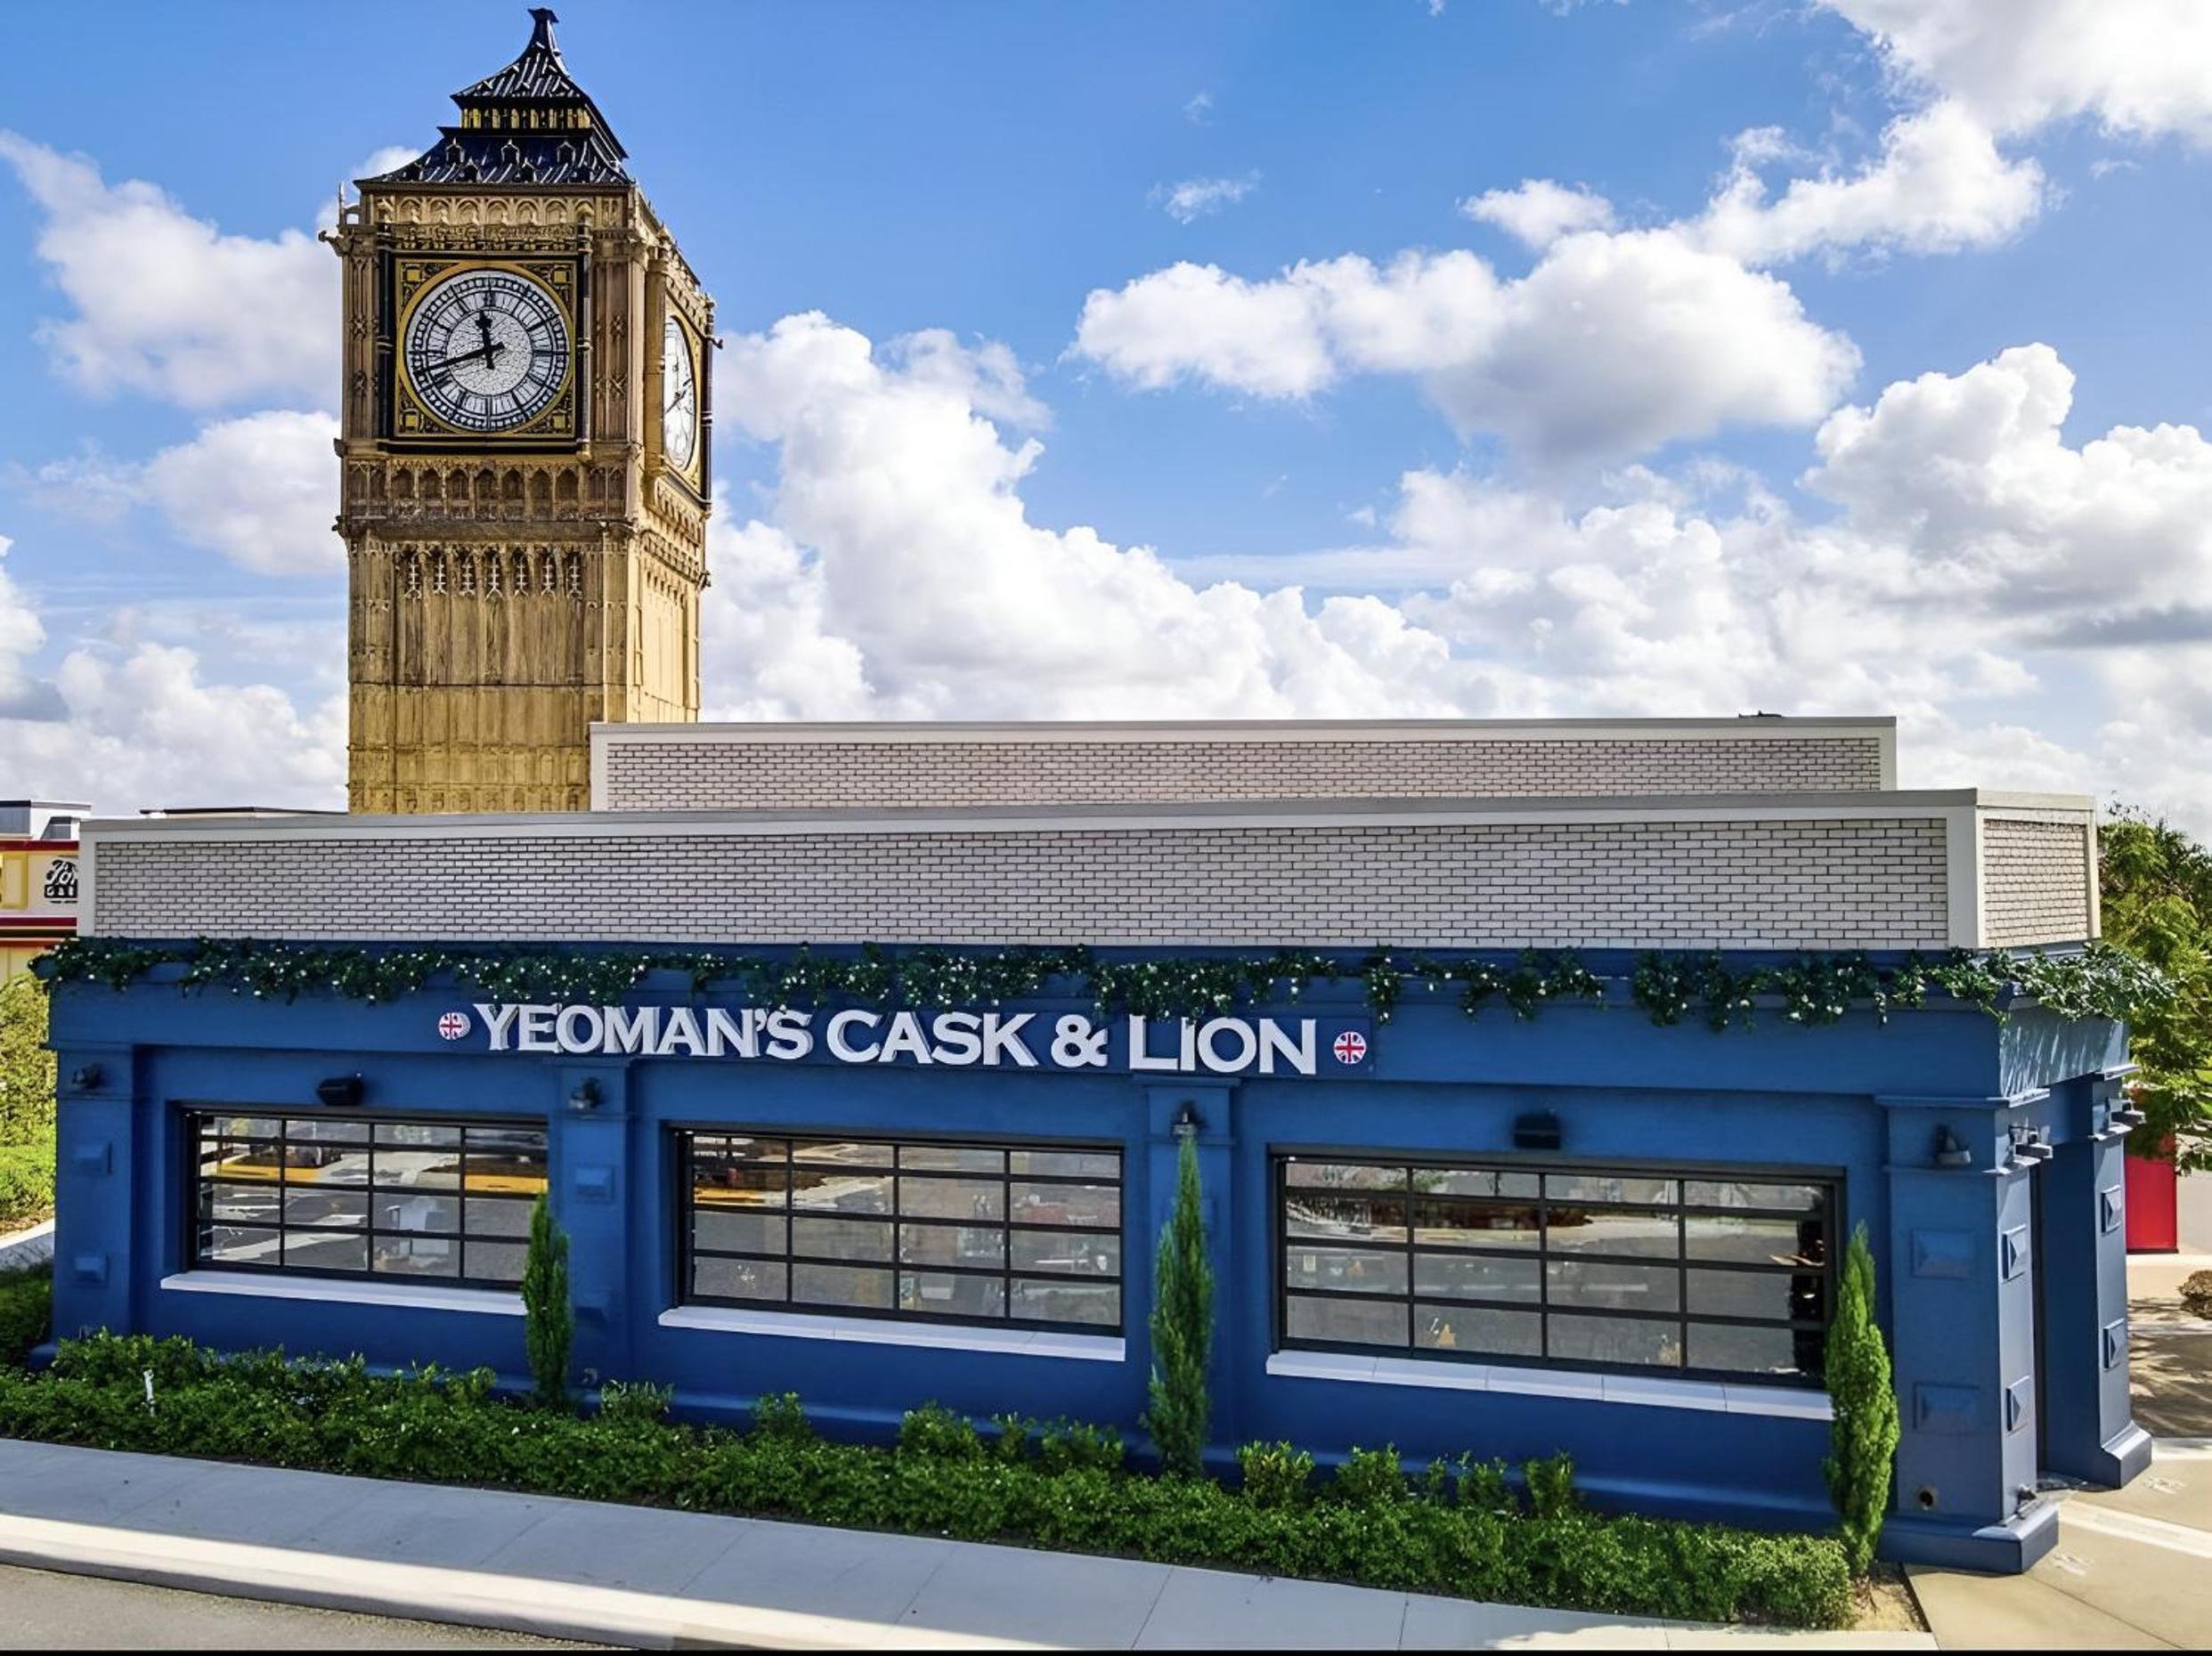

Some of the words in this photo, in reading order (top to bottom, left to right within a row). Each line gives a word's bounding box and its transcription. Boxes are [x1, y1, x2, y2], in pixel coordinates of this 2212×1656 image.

[473, 1003, 814, 1060] YEOMAN'S
[826, 1010, 1039, 1067] CASK
[1050, 1015, 1109, 1067] &
[1128, 1014, 1316, 1076] LION
